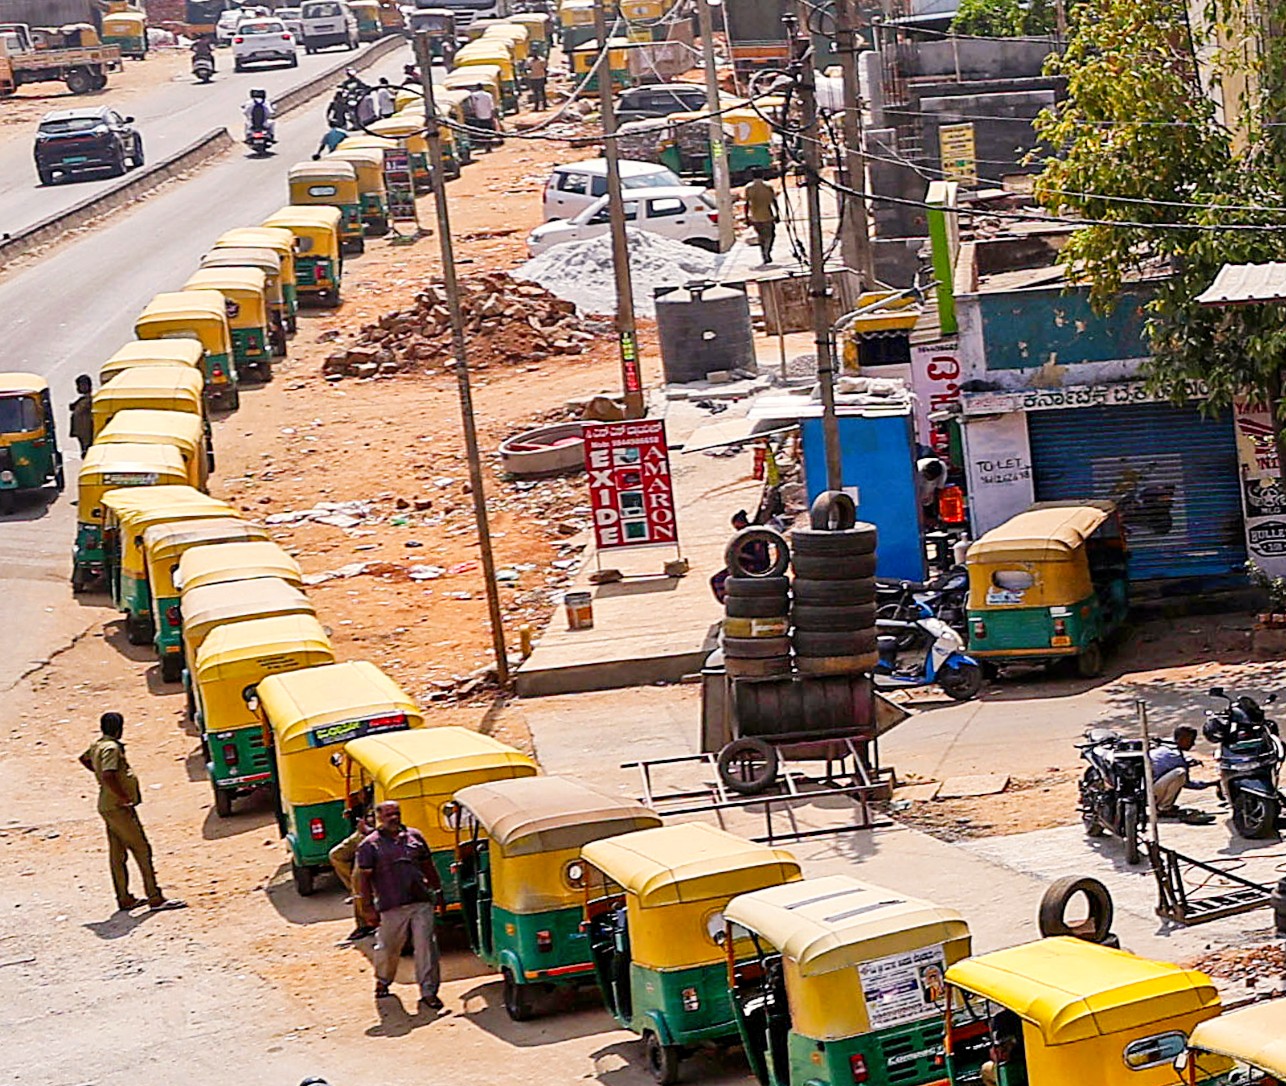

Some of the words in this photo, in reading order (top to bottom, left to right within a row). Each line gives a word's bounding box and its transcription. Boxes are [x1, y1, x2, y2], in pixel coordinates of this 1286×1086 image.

[589, 449, 619, 545] EXIDE
[643, 445, 675, 540] AMARON
[975, 460, 993, 473] TO
[997, 458, 1022, 469] LET
